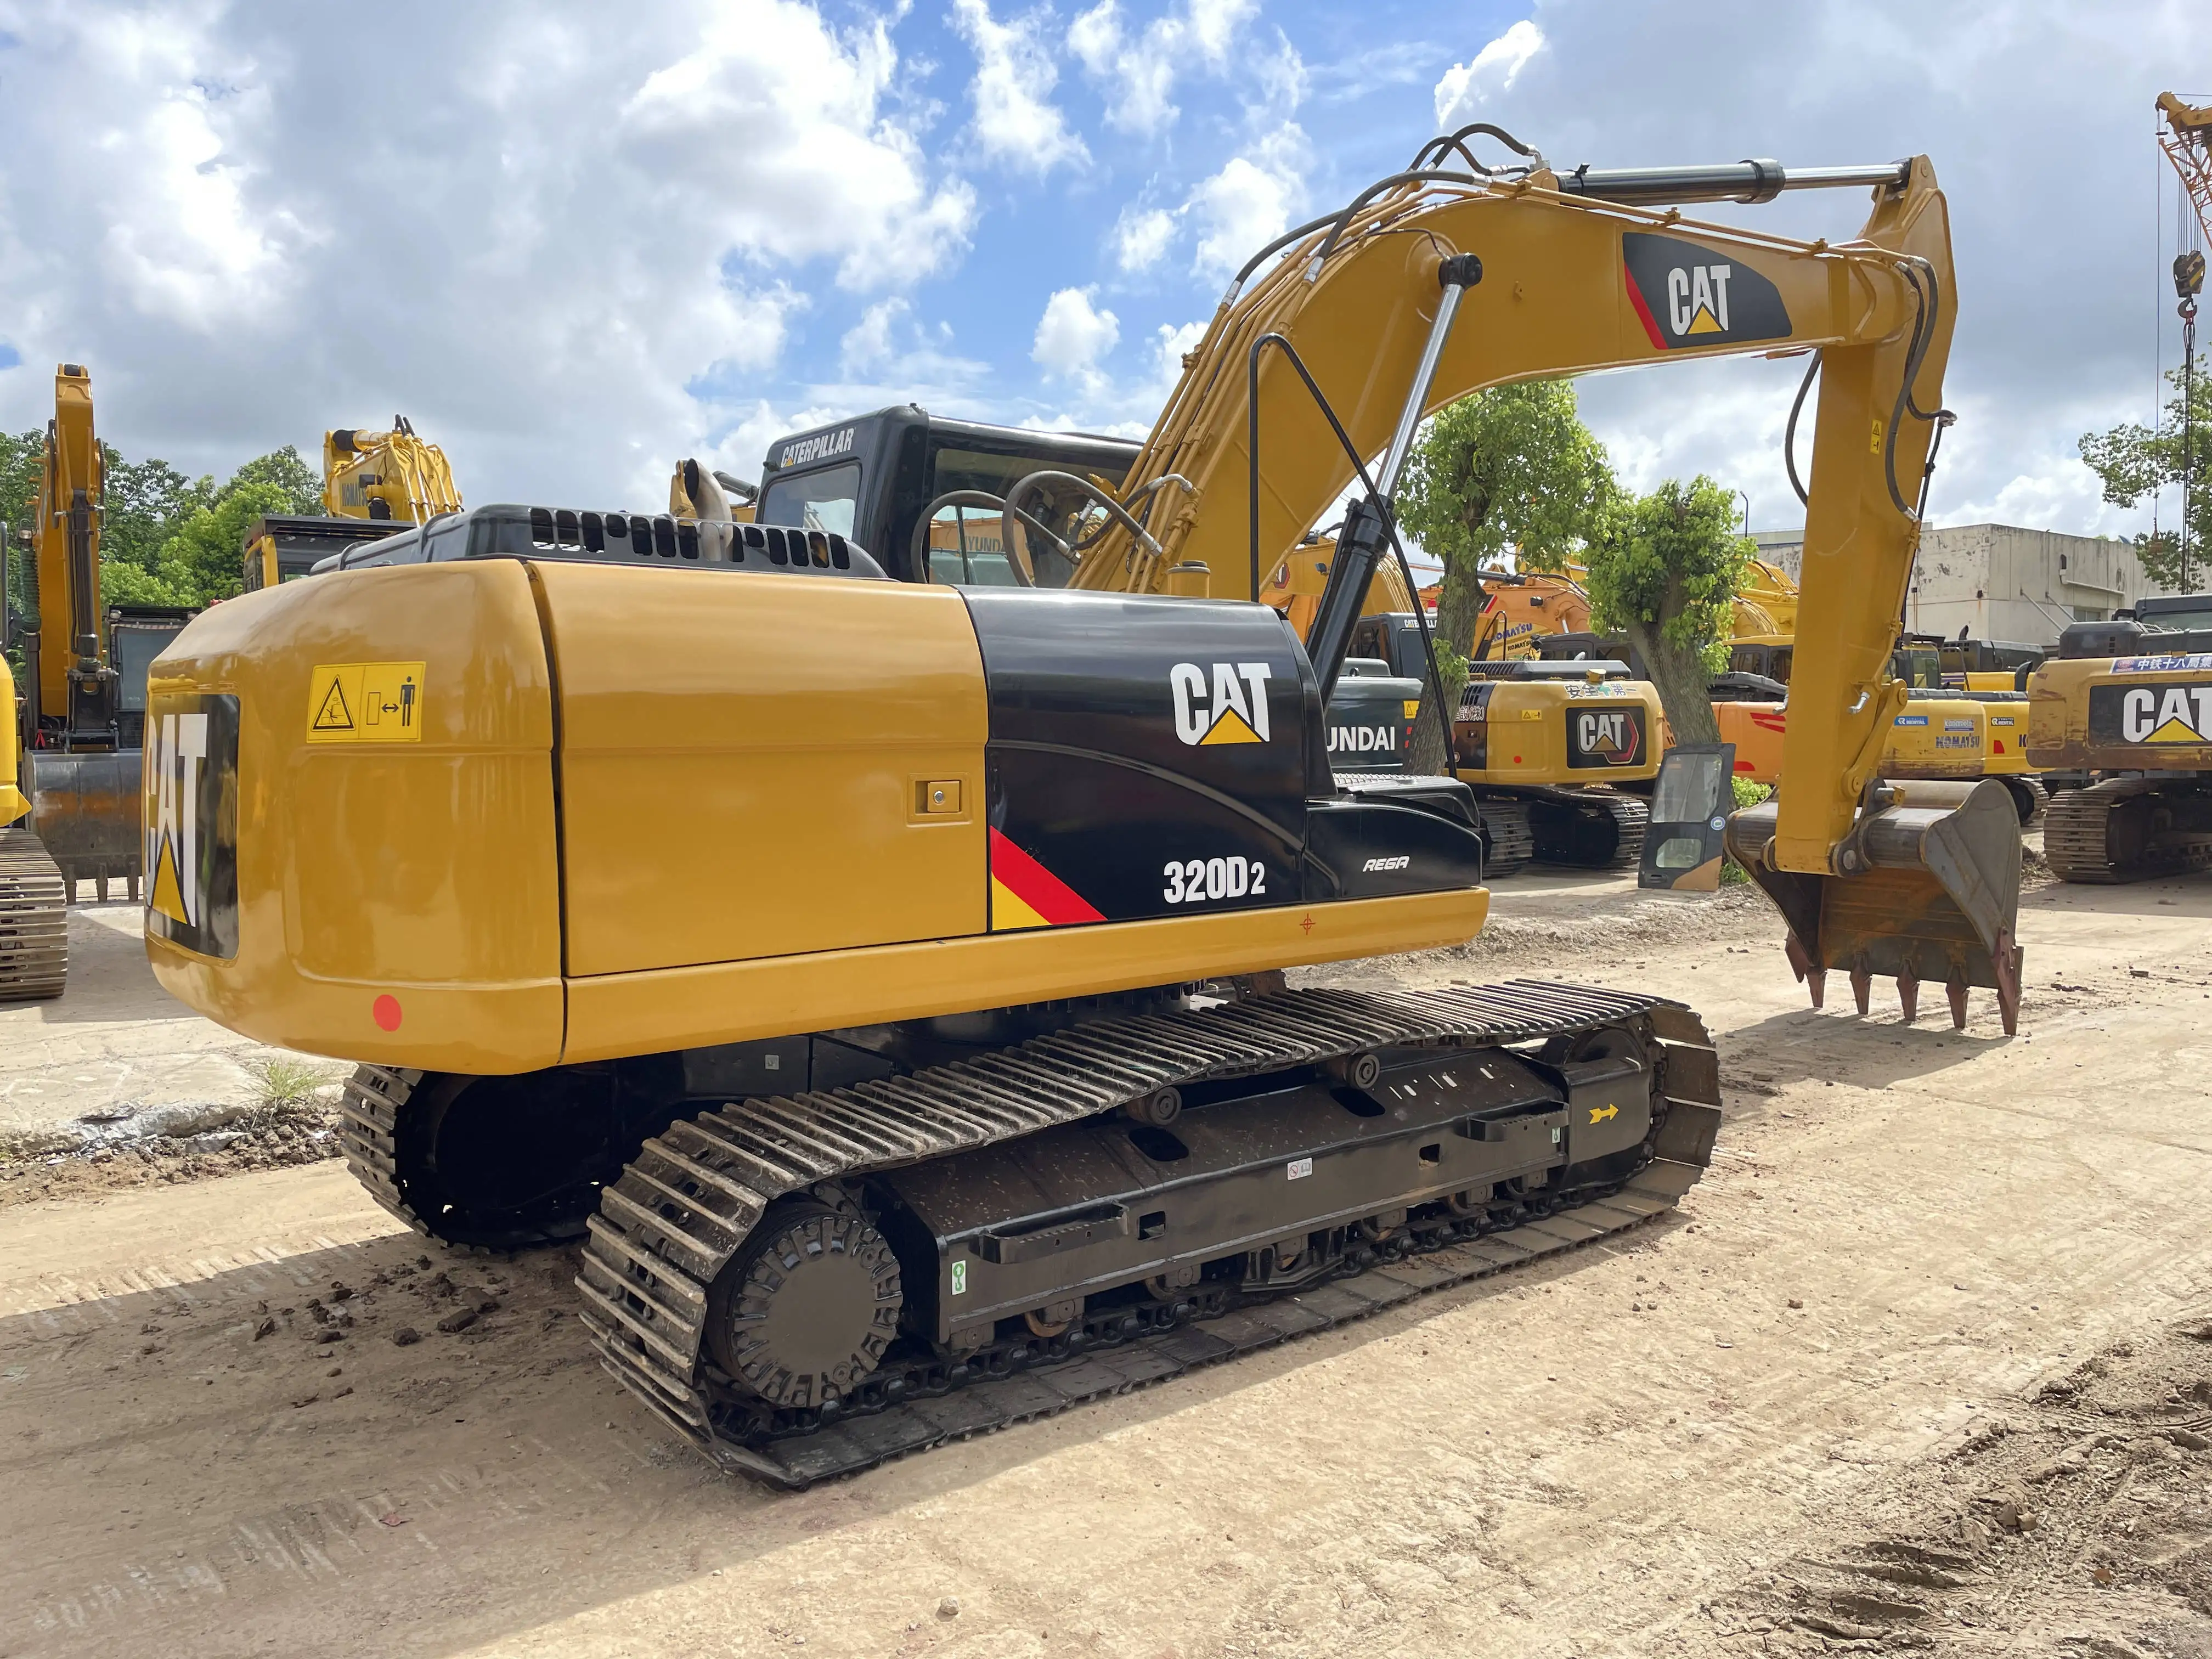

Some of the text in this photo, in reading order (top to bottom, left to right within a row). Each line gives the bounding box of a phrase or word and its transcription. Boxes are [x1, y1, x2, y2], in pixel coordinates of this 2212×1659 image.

[1668, 265, 1731, 335] CAT
[781, 427, 855, 468] CATERPILLAR
[342, 483, 369, 506] KOMATS
[965, 535, 1005, 551] YUND
[1170, 663, 1272, 746] CAT
[2123, 687, 2212, 743] CAT
[1327, 726, 1395, 752] UNDAI
[1579, 714, 1624, 752] CAT
[145, 713, 208, 927] CAT
[1164, 856, 1266, 904] 320D2
[1362, 855, 1410, 872] REGA
